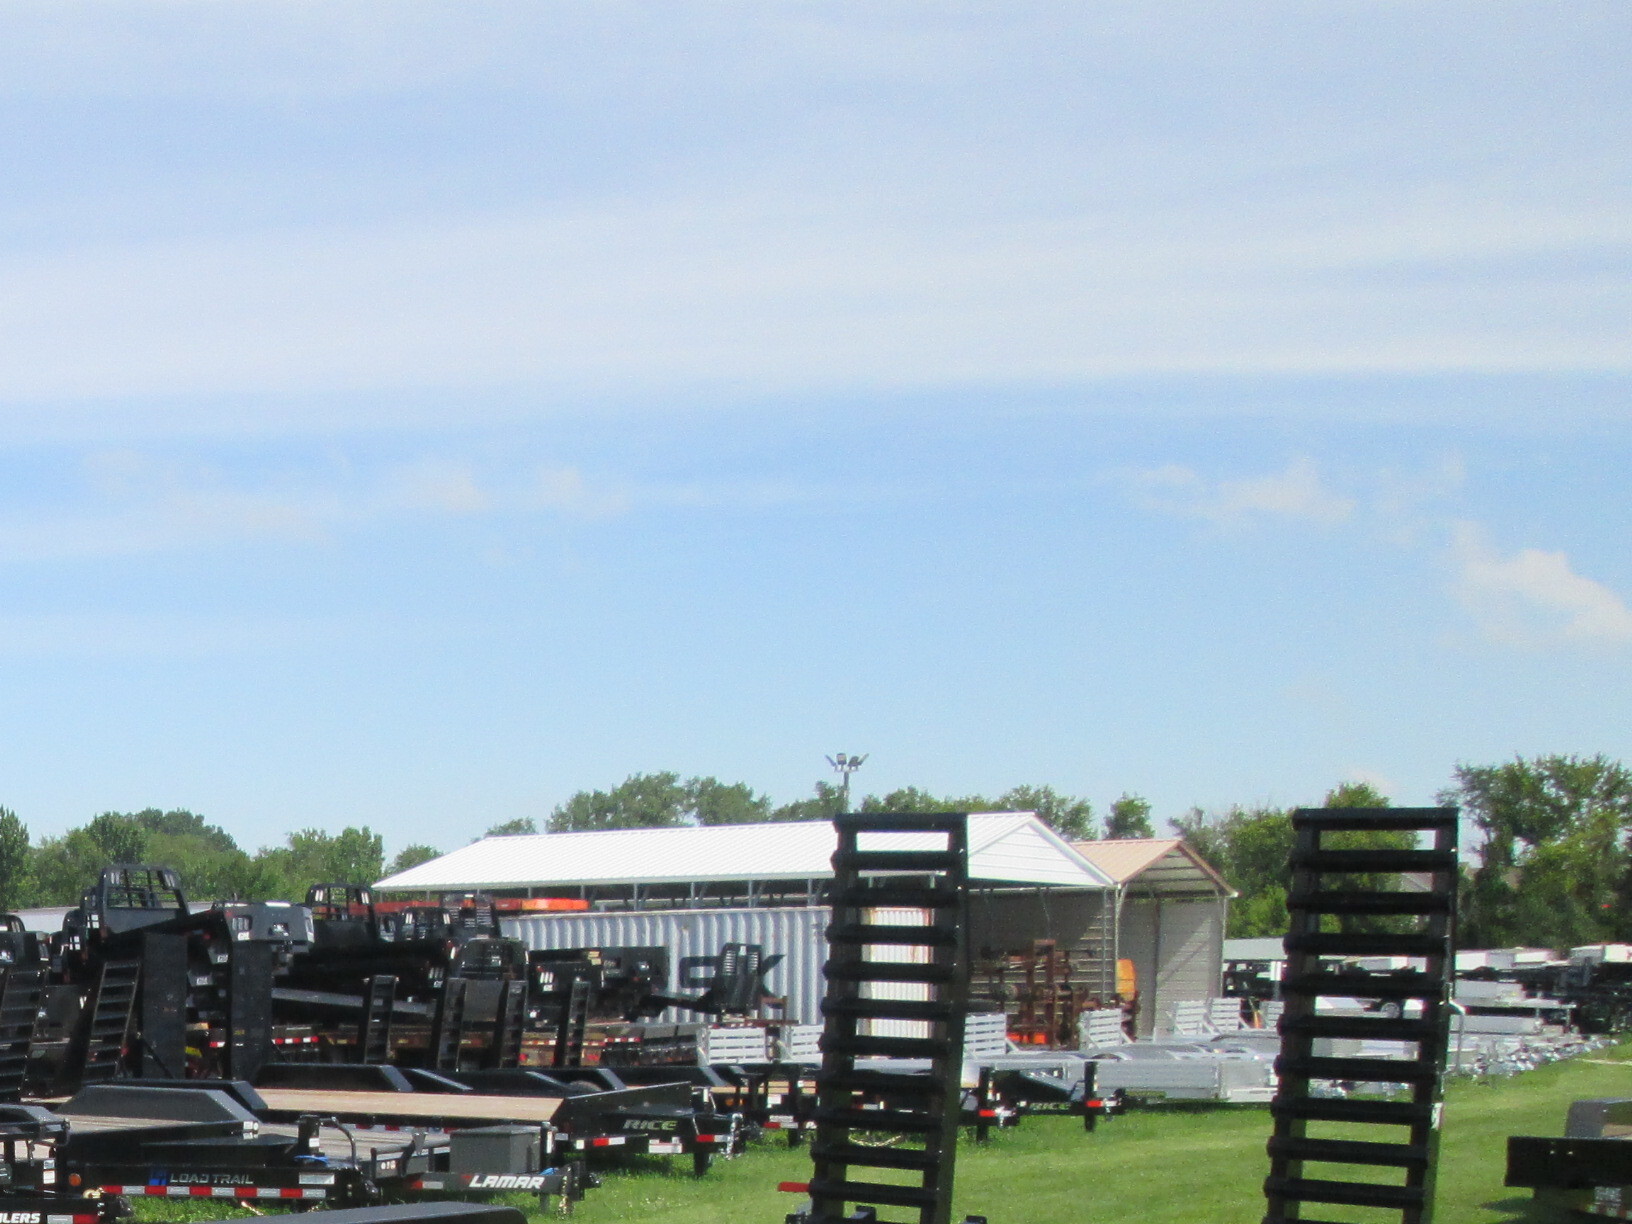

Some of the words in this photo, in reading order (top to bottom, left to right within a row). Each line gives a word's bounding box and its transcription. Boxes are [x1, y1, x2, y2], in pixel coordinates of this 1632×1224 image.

[622, 1119, 678, 1131] RICE
[169, 1173, 209, 1184] LOAD
[212, 1174, 254, 1185] TRAIL
[469, 1175, 545, 1189] LAMAR
